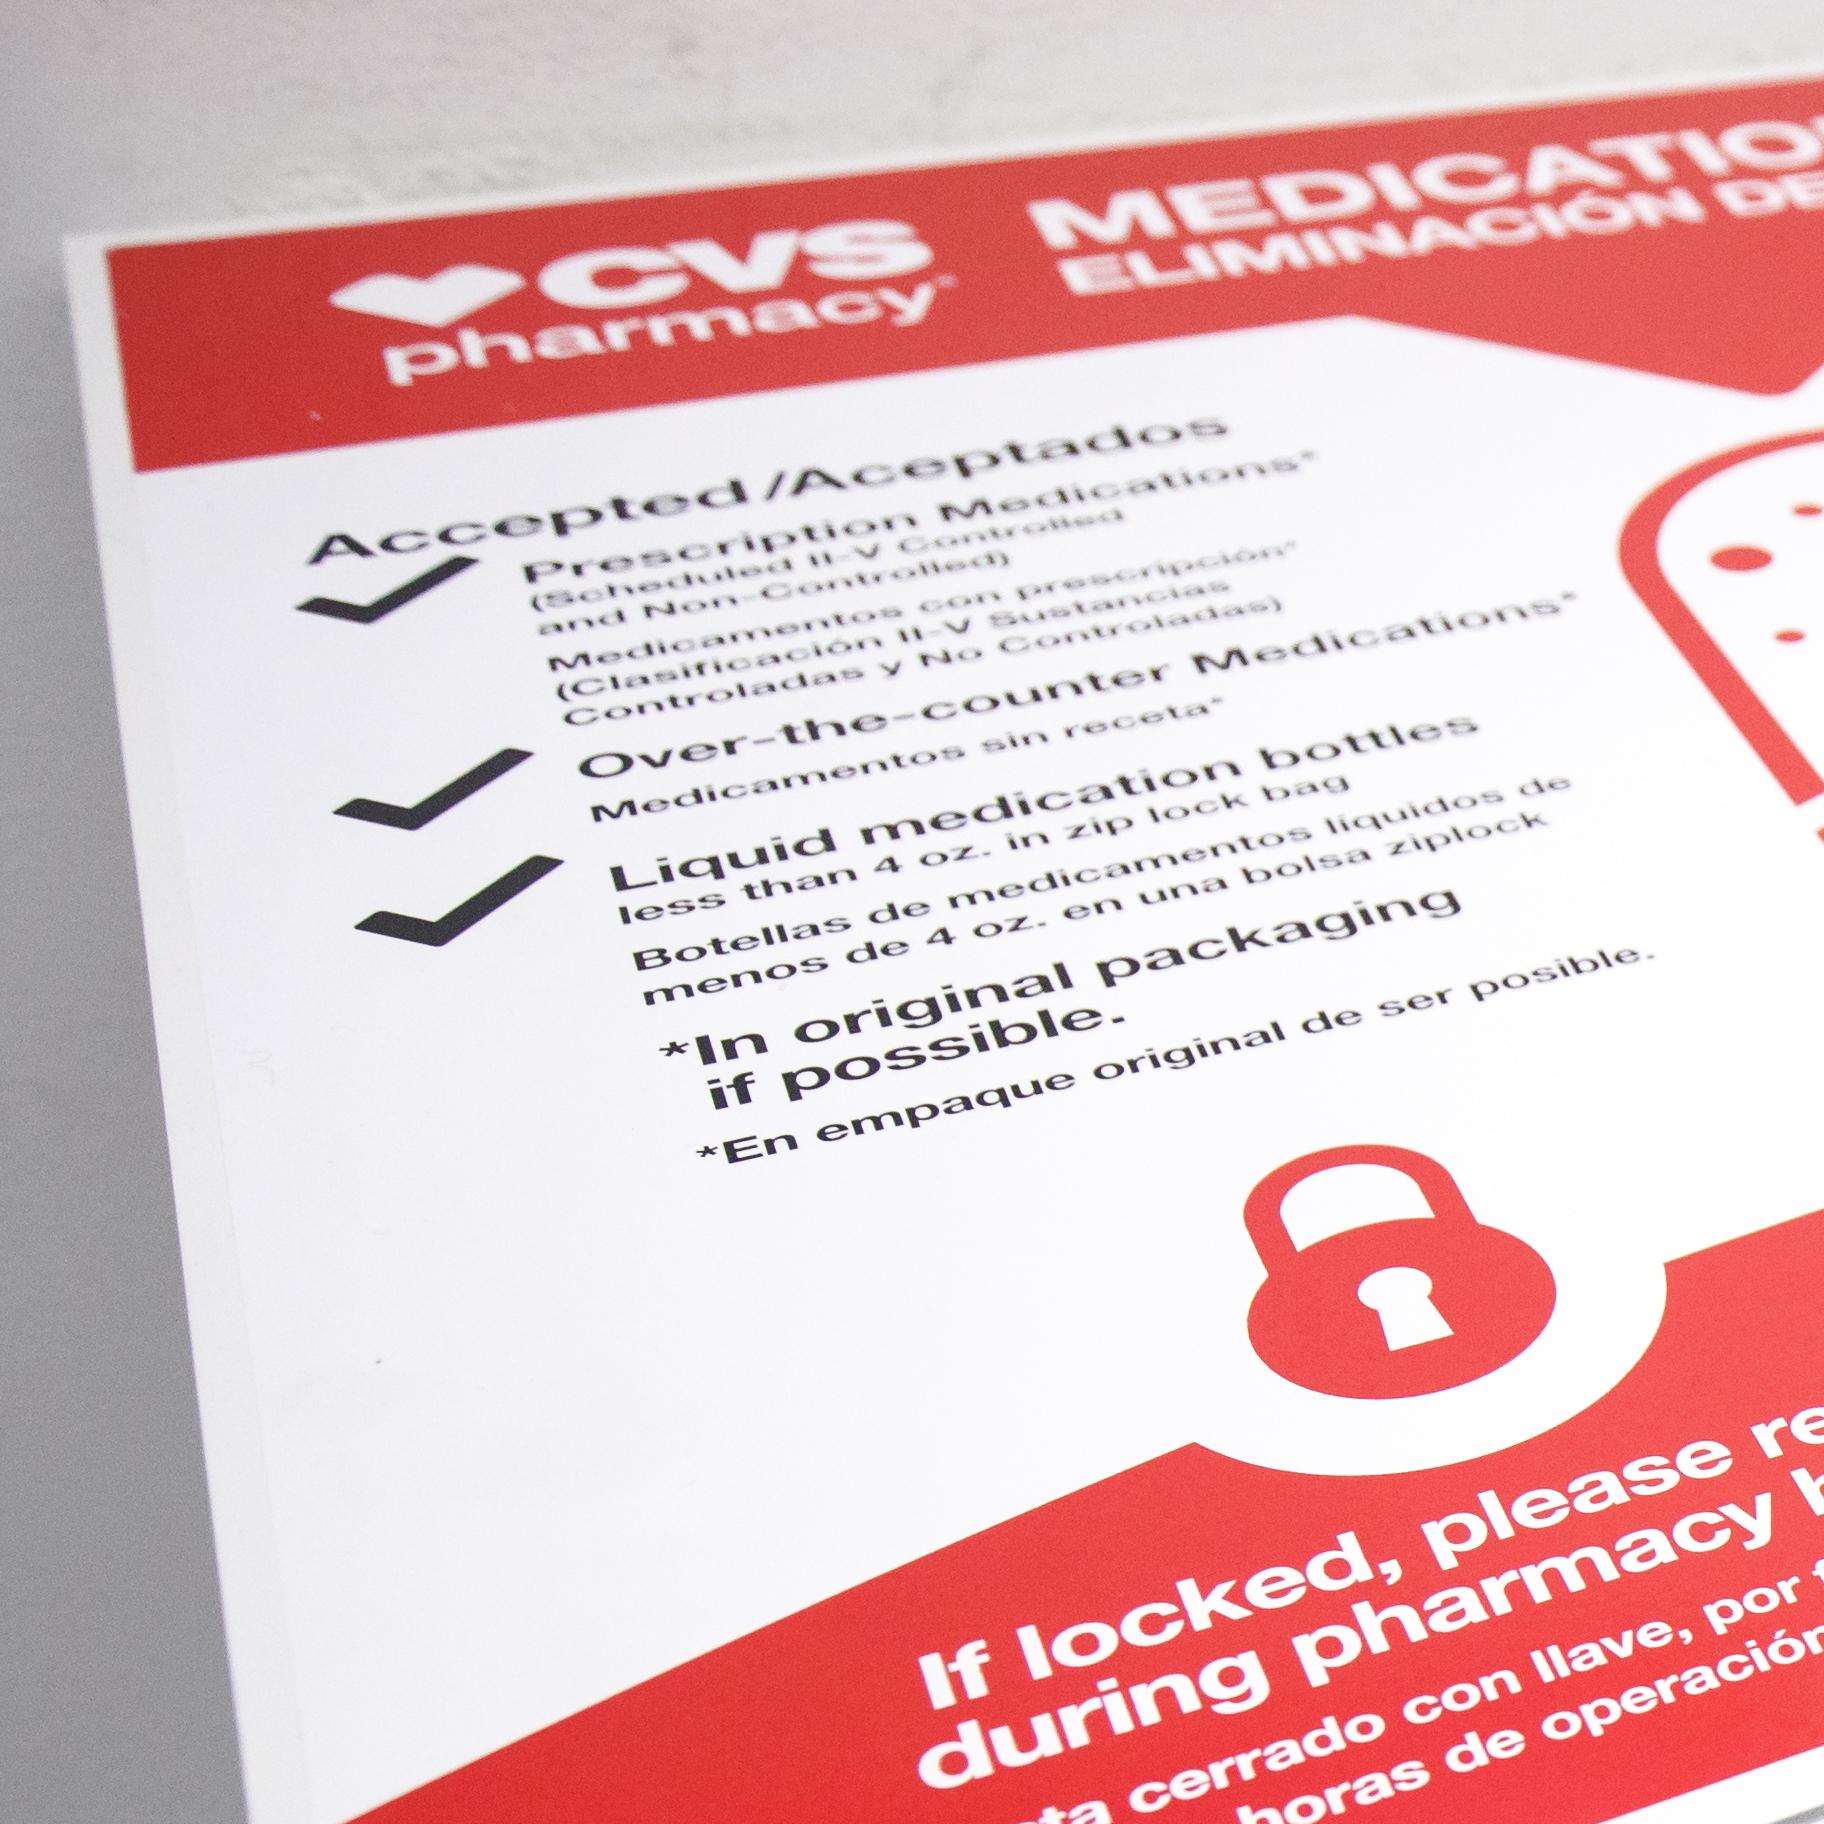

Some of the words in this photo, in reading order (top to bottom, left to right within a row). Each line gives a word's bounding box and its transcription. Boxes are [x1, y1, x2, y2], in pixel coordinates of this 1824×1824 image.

[538, 220, 933, 308] CVS
[1059, 188, 1705, 295] ELIMINACIÓN
[384, 282, 936, 386] pharmacy
[523, 515, 917, 585] Prescription
[530, 558, 793, 613] (Scheduled
[897, 508, 1125, 554] Controlled
[539, 609, 626, 636] and
[642, 553, 1010, 620] Non-Controlled)
[547, 609, 902, 673] Medicamentos
[919, 591, 1002, 613] con
[556, 638, 882, 703] (Clasificación
[988, 583, 1230, 629] Sustancias
[563, 670, 864, 726] Controladas
[880, 661, 901, 678] y
[919, 650, 983, 668] No
[998, 598, 1283, 654] Controladas)
[578, 668, 1162, 779] Over-the-counter
[591, 749, 965, 823] Medicamentos
[982, 732, 1049, 752] sin
[610, 828, 837, 892] Liquid
[860, 762, 1241, 845] medication
[1259, 721, 1478, 770] bottles
[619, 894, 726, 925] less
[743, 869, 857, 900] than
[875, 856, 901, 873] 4
[919, 846, 990, 867] oz.
[1008, 833, 1050, 850] in
[1068, 818, 1134, 840] zip
[1148, 794, 1247, 824] lock
[1261, 777, 1350, 802] bag
[633, 918, 851, 971] Botellas
[868, 902, 930, 924] de
[948, 830, 1312, 909] medicamentos
[1519, 778, 1571, 796] de
[643, 957, 829, 1006] menos
[846, 941, 909, 964] de
[927, 927, 955, 945] 4
[973, 916, 1046, 938] oz.
[1063, 899, 1123, 920] en
[1139, 878, 1228, 905] una
[1241, 850, 1372, 885] bolsa
[1390, 813, 1546, 856] ziplock
[794, 962, 1074, 1043] original
[1096, 891, 1461, 988] packaging
[707, 1071, 755, 1110] if
[781, 1009, 1125, 1102] possible.
[816, 1074, 1075, 1142] empaque
[1093, 1021, 1286, 1080] original
[1302, 1011, 1361, 1034] de
[1378, 989, 1451, 1017] ser
[1469, 950, 1653, 1002] posible.
[919, 1640, 990, 1710] If
[1017, 1531, 1402, 1680] locked,
[1421, 1441, 1733, 1570] please
[918, 1650, 1270, 1789] during
[1292, 1492, 1772, 1687] pharmacy
[1129, 1714, 1385, 1813] cerrado
[1403, 1670, 1522, 1724] con
[1530, 1621, 1693, 1683] llave,
[1703, 1576, 1800, 1635] por
[1446, 1730, 1525, 1772] de
